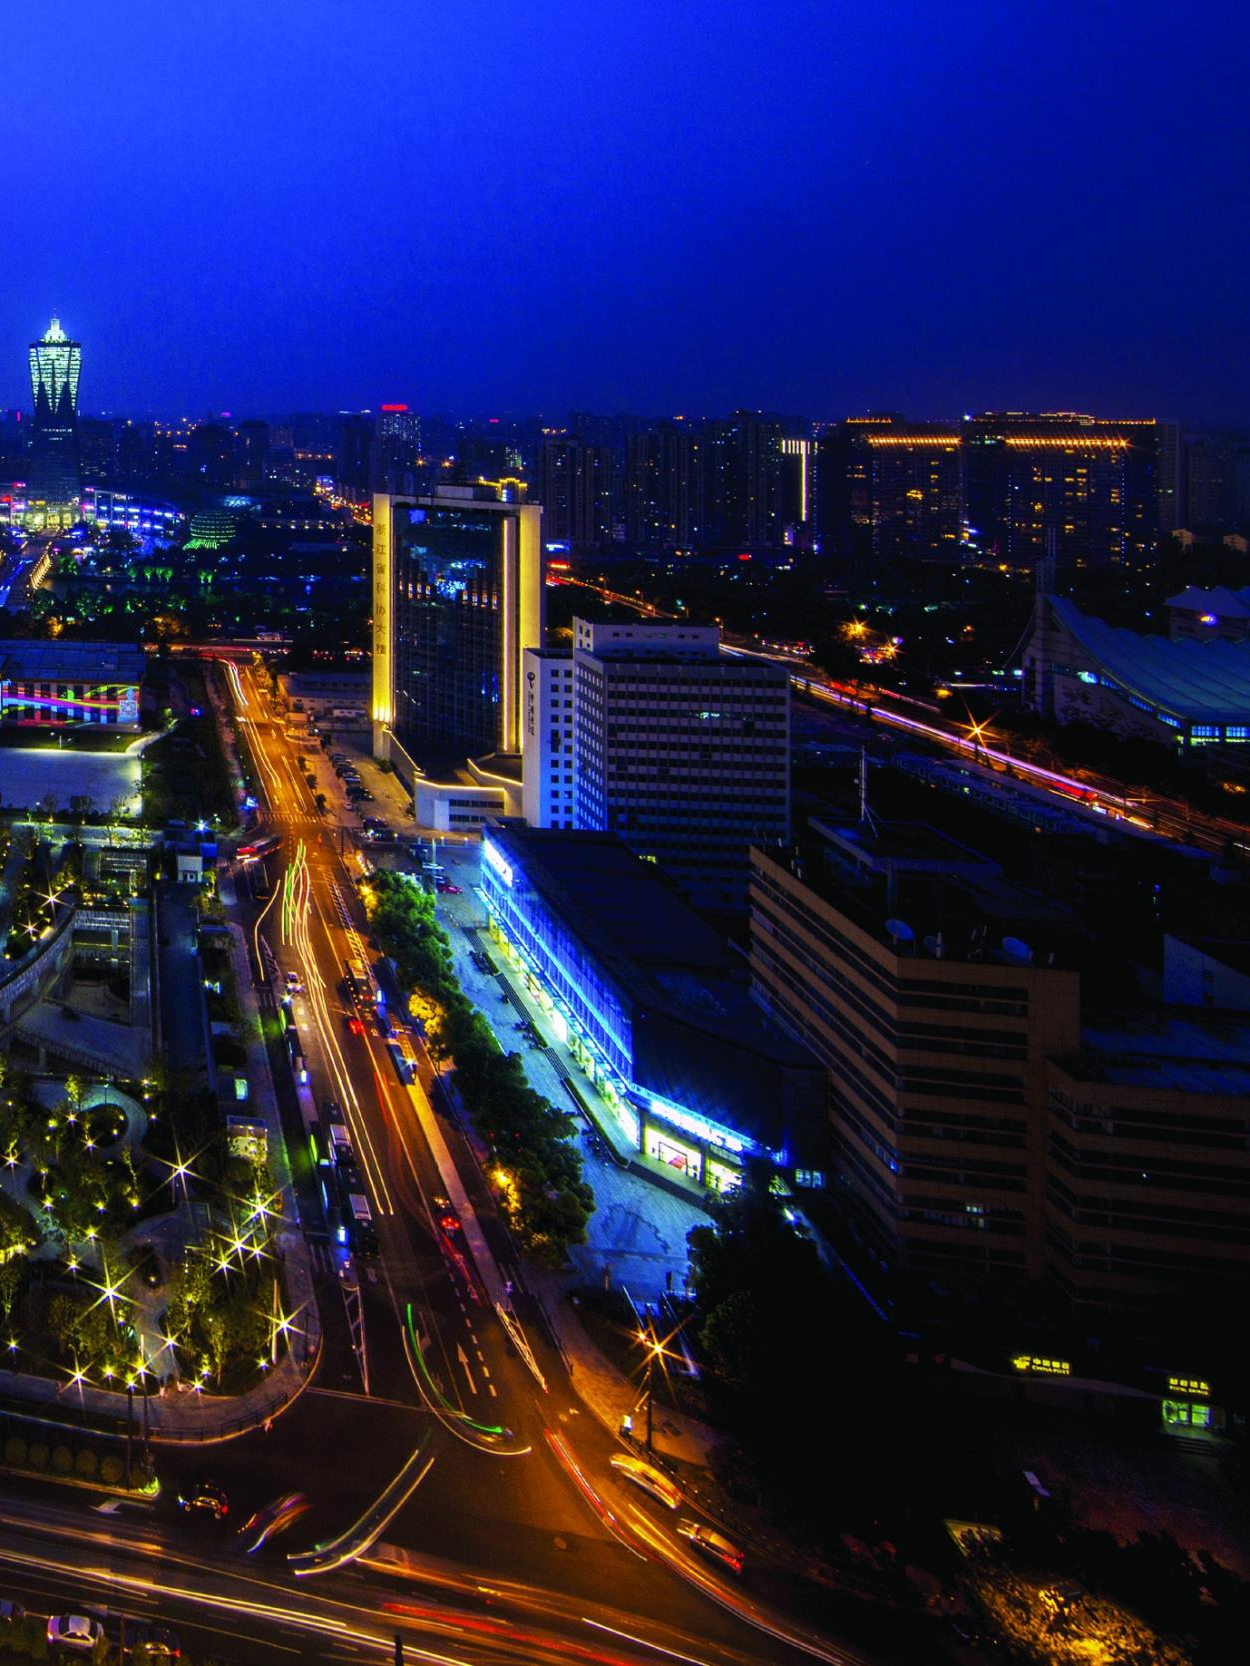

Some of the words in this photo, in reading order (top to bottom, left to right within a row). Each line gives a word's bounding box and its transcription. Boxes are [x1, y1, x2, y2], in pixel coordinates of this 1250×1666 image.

[375, 524, 387, 655] 浙江省科协大楼
[1032, 1358, 1070, 1370] 中国邮政
